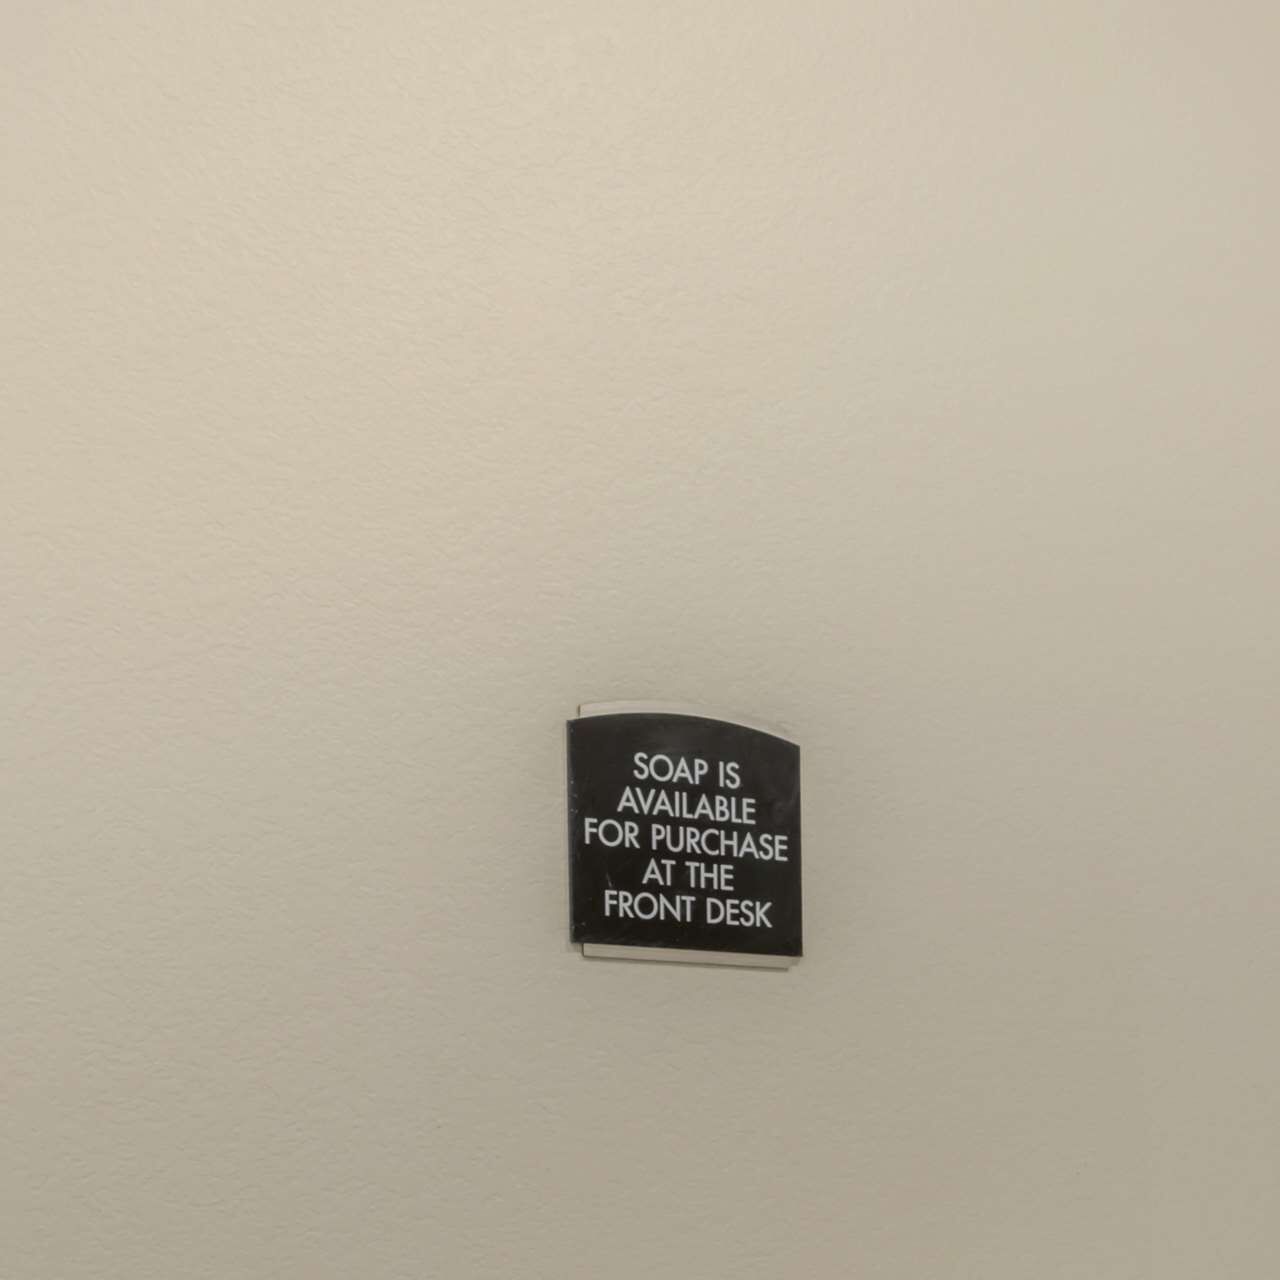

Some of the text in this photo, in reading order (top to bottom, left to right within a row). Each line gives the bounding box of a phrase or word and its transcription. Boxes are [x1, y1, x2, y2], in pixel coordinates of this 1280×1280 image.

[633, 752, 741, 789] SOAP IS
[617, 786, 756, 824] AVAILABLE
[584, 817, 788, 861] FOR PURCHASE
[642, 857, 734, 891] AT THE
[604, 889, 773, 928] FRONT DESK
